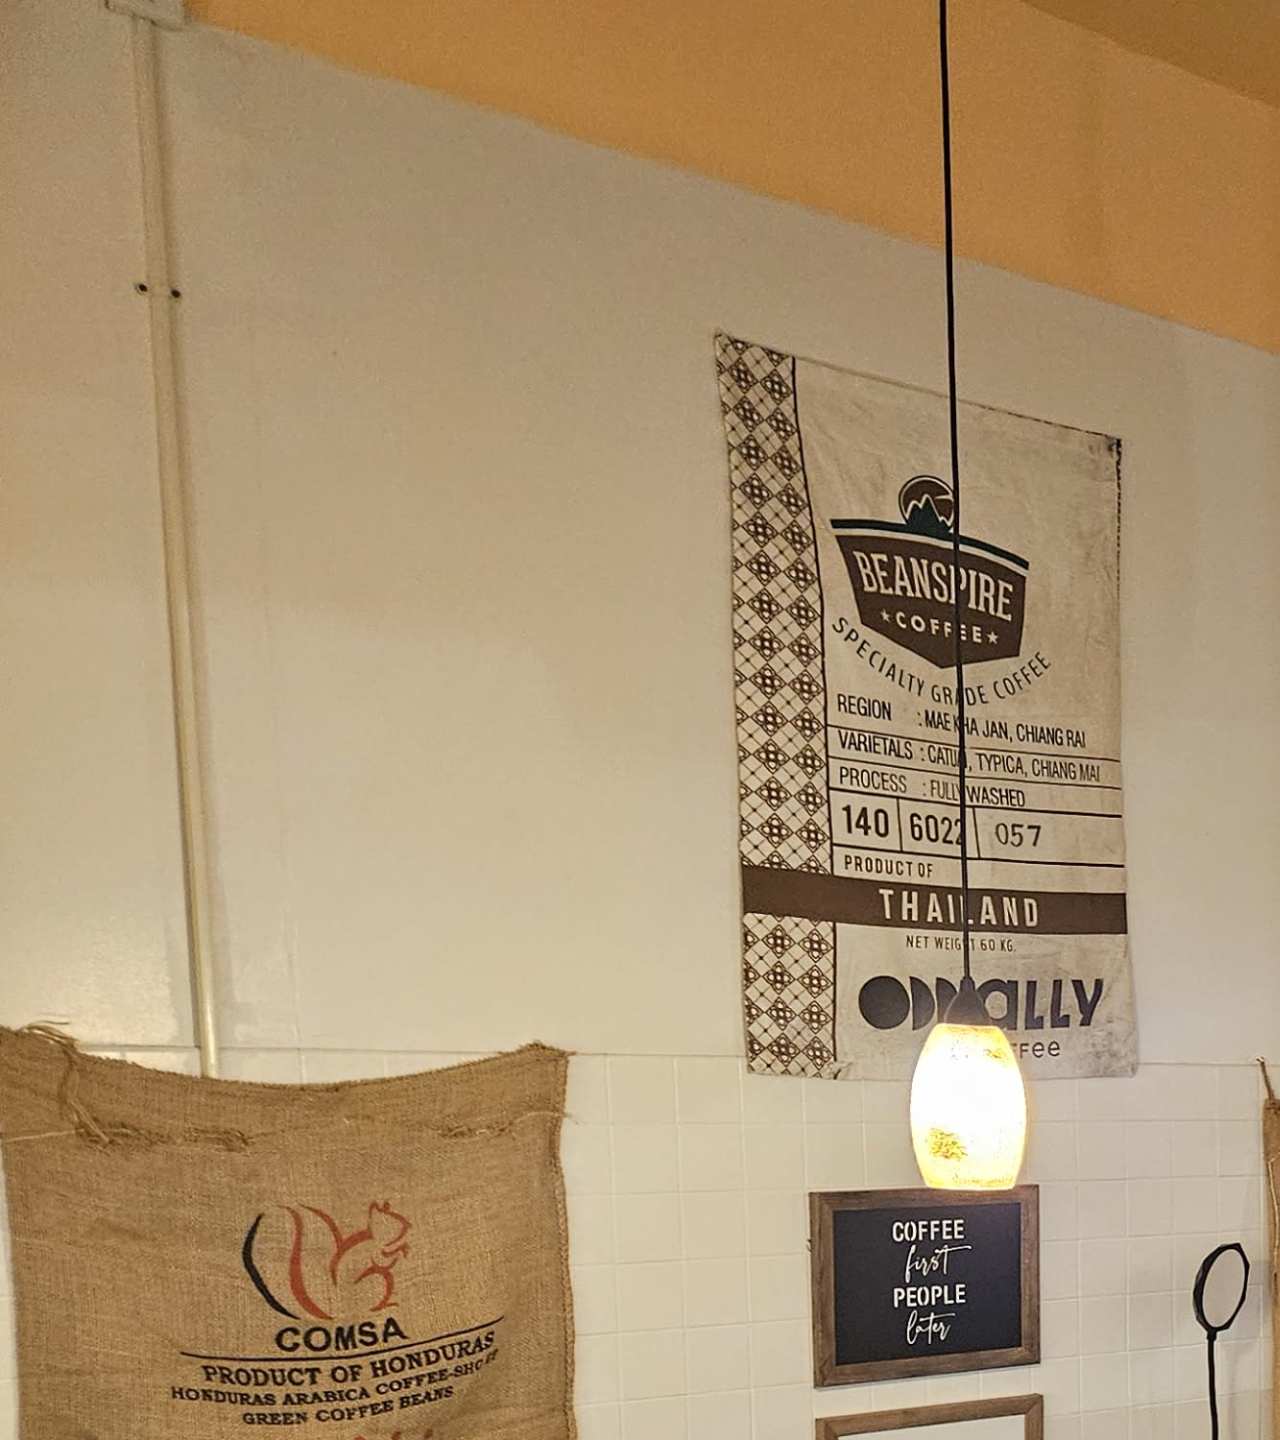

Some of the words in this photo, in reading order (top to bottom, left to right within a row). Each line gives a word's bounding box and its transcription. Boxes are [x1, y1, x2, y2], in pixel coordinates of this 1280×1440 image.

[853, 551, 1013, 621] BEANSPIRE
[896, 611, 982, 643] COFFEE
[832, 617, 924, 696] SPECIALTY
[993, 652, 1051, 699] COFFEE
[837, 693, 892, 721] REGION
[925, 709, 951, 731] MAE
[982, 720, 1013, 743] JAN,
[1016, 724, 1063, 744] CHIANG
[1066, 730, 1086, 748] RAI
[838, 730, 913, 760] VARIETALS
[978, 752, 1028, 777] TYPICA,
[1032, 755, 1076, 780] CHIANG
[1079, 761, 1101, 783] MAI
[839, 766, 907, 794] PROCESS
[930, 779, 961, 801] FULLY
[966, 785, 1026, 808] WASHED
[841, 804, 890, 838] 140
[910, 813, 963, 846] 6022
[995, 822, 1042, 848] 057
[844, 855, 912, 877] PRODUCT
[918, 863, 934, 878] OF
[878, 888, 1038, 928] THAILAND
[906, 935, 932, 950] NET
[935, 936, 976, 951] WEIGT
[980, 938, 996, 951] 60
[892, 1219, 964, 1242] COFFEE
[905, 1244, 972, 1283] first
[893, 1284, 966, 1308] PEOPLE
[275, 1316, 408, 1353] COMSA
[906, 1310, 956, 1345] later
[202, 1365, 321, 1388] PRODUCT
[331, 1364, 365, 1384] OF
[370, 1331, 495, 1379] HONDURAS
[171, 1386, 277, 1405] HONDURAS
[283, 1388, 371, 1406] ARABICA
[243, 1411, 308, 1426] GREEN
[315, 1402, 395, 1424] COFFEE
[399, 1385, 454, 1409] BEANS
